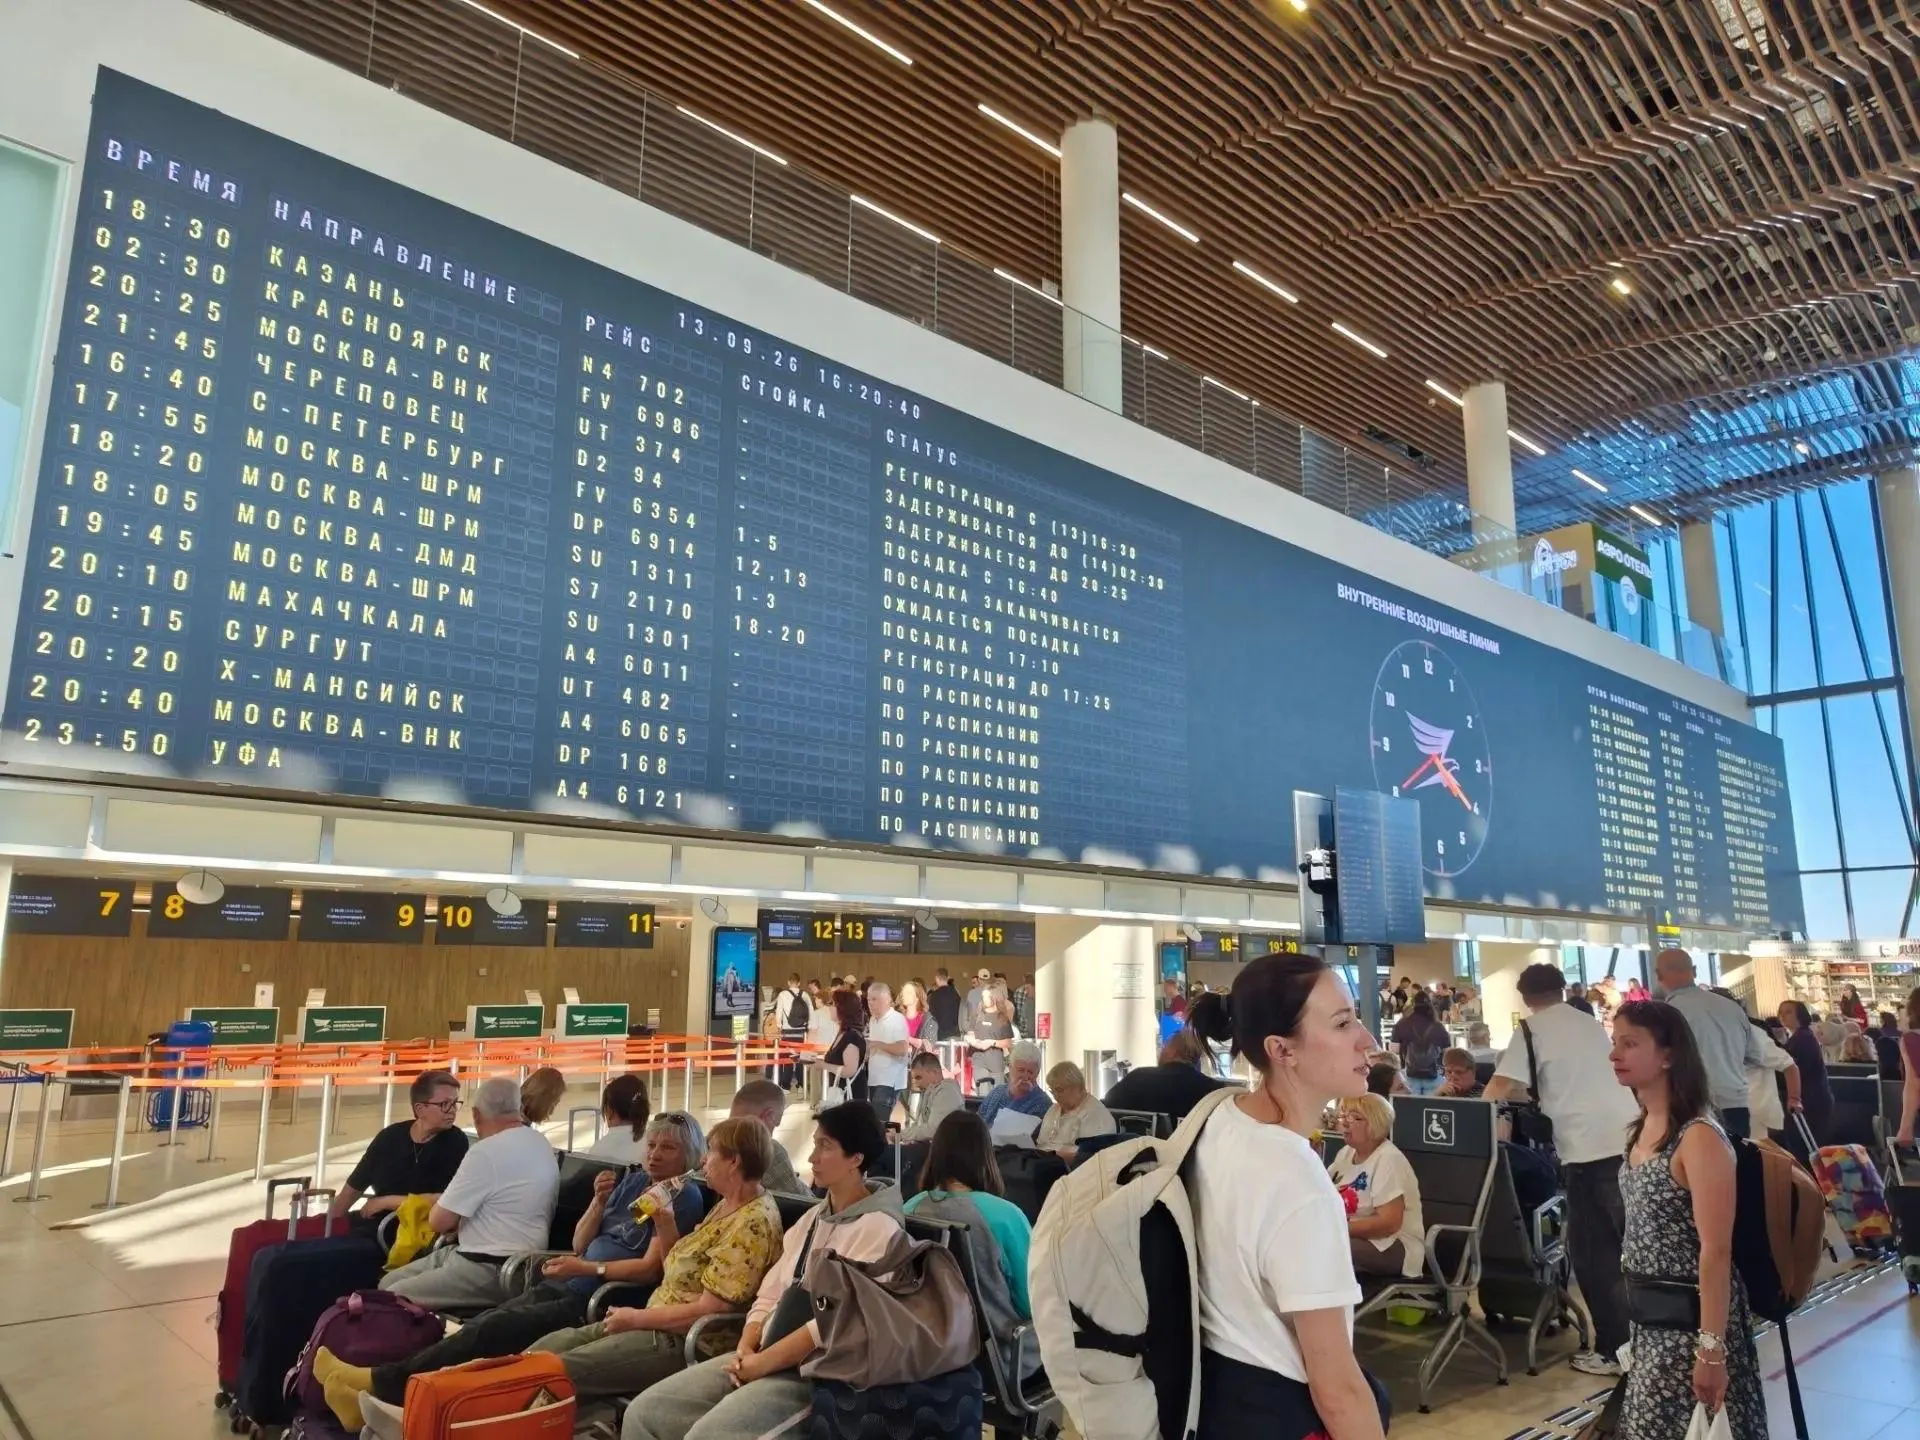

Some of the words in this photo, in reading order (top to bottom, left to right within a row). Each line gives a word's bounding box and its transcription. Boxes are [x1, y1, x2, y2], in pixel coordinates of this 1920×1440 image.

[107, 139, 237, 202] ВРЕМЯ
[103, 189, 230, 249] 18:30
[95, 227, 226, 285] 02:30
[275, 199, 516, 304] НАПРАВЛЕНИЕ
[90, 265, 221, 322] 20:25
[269, 245, 404, 308] КАЗАНЬ
[84, 304, 217, 359] 21:45
[265, 281, 490, 372] КРАСНОЯРСК
[585, 315, 651, 354] РЕЙС
[81, 343, 212, 397] 16:40
[259, 316, 488, 404] МОСКВА-ВНК
[582, 355, 612, 380] N4
[640, 375, 684, 405] 702
[679, 312, 797, 372] 13.09.26
[819, 368, 920, 420] 16:20:40
[75, 383, 207, 434] 17:55
[257, 352, 464, 434] ЧЕРЕПОВЕЦ
[582, 386, 611, 410] FV
[637, 405, 699, 440] 6986
[741, 374, 826, 419] СТОЙКА
[70, 423, 202, 473] 18:20
[252, 391, 504, 475] С-ПЕТЕРБУРГ
[579, 417, 609, 441] UT
[636, 435, 681, 464] 374
[886, 428, 957, 466] СТАТУС
[246, 427, 481, 505] МОСКВА-ШРМ
[577, 448, 607, 473] D2
[634, 466, 662, 489] 94
[64, 464, 197, 512] 18:05
[242, 464, 479, 538] МОСКВА-ШРМ
[576, 480, 605, 504] FV
[633, 497, 696, 529] 6354
[886, 462, 1014, 519] РЕГИСТРАЦИЯ
[1028, 511, 1037, 527] С
[58, 505, 193, 551] 19:45
[237, 502, 476, 576] МОСКВА-ДМД
[573, 512, 603, 535] DP
[631, 528, 694, 559] 6914
[737, 526, 777, 551] 1-5
[885, 488, 1036, 549] ЗАДЕРЖИВАЕТСЯ
[1049, 543, 1068, 560] ДО
[48, 546, 188, 591] 20:10
[233, 541, 474, 608] МОСКВА-ШРМ
[571, 545, 602, 568] SU
[630, 559, 692, 589] 1311
[884, 541, 968, 578] ПОСАДКА
[983, 569, 993, 585] С
[1007, 577, 1057, 604] 16:40
[885, 515, 1036, 573] ЗАДЕРЖИВАЕТСЯ
[1049, 566, 1068, 583] ДО
[1081, 576, 1127, 601] 20:25
[42, 588, 183, 632] 20:15
[228, 580, 446, 638] МАХАЧКАЛА
[570, 577, 599, 599] S7
[627, 590, 692, 620] 2170
[735, 585, 775, 609] 1-3
[884, 567, 968, 603] ПОСАДКА
[984, 595, 1119, 644] ЗАКАНЧИВАЕТСЯ
[1337, 582, 1406, 621] ВНУТРЕННИЕ
[1406, 608, 1468, 643] ВОЗДУШНЫЕ
[1469, 632, 1501, 655] ЛИНИИ
[225, 619, 372, 662] СУРГУТ
[567, 610, 598, 632] SU
[627, 622, 688, 651] 1301
[734, 615, 805, 645] 18-20
[883, 594, 992, 634] ОЖИДАЕТСЯ
[1008, 626, 1079, 657] ПОСАДКА
[36, 631, 178, 672] 20:20
[565, 643, 596, 665] A4
[624, 654, 687, 682] 6011
[883, 621, 968, 654] ПОСАДКА
[983, 644, 993, 661] С
[1008, 651, 1059, 675] 17:10
[1424, 658, 1434, 675] 12
[220, 659, 464, 714] Х-МАНСИЙСК
[884, 648, 1015, 690] РЕГИСТРАЦИЯ
[1029, 680, 1048, 697] ДО
[1063, 688, 1110, 711] 17:25
[1402, 663, 1411, 679] 11
[1449, 678, 1455, 693] 1
[30, 674, 173, 714] 20:40
[563, 676, 594, 698] UT
[622, 687, 670, 711] 482
[883, 675, 905, 694] ПО
[923, 684, 1038, 720] РАСПИСАНИЮ
[1385, 691, 1396, 707] 10
[23, 718, 168, 756] 23:50
[214, 699, 461, 750] МОСКВА-ВНК
[560, 710, 591, 732] A4
[621, 719, 686, 745] 6065
[882, 703, 904, 721] ПО
[923, 710, 1039, 745] РАСПИСАНИЮ
[1466, 715, 1473, 729] 2
[212, 740, 281, 768] УФА
[559, 744, 591, 765] DP
[620, 752, 667, 775] 168
[882, 730, 904, 748] ПО
[922, 737, 1039, 769] РАСПИСАНИЮ
[1382, 736, 1390, 752] 9
[881, 758, 903, 776] ПО
[922, 764, 1039, 795] РАСПИСАНИЮ
[1475, 759, 1482, 773] 3
[556, 779, 588, 799] A4
[617, 785, 682, 809] 6121
[881, 787, 903, 804] ПО
[922, 792, 1039, 820] РАСПИСАНИЮ
[1473, 801, 1480, 815] 4
[880, 815, 903, 832] ПО
[921, 820, 1039, 846] РАСПИСАНИЮ
[1437, 839, 1445, 855] 6
[1459, 831, 1466, 845] 5
[100, 891, 120, 917] 7
[165, 894, 184, 919] 8
[398, 904, 415, 927] 9
[443, 905, 472, 928] 10
[629, 912, 651, 934] 11
[814, 920, 832, 939] 12
[846, 922, 864, 940] 13
[962, 926, 978, 943] 14
[987, 927, 1003, 944] 15
[1219, 937, 1232, 952] 18
[1269, 940, 1279, 954] 19
[1286, 941, 1297, 954] 20
[1348, 945, 1358, 957] 21
